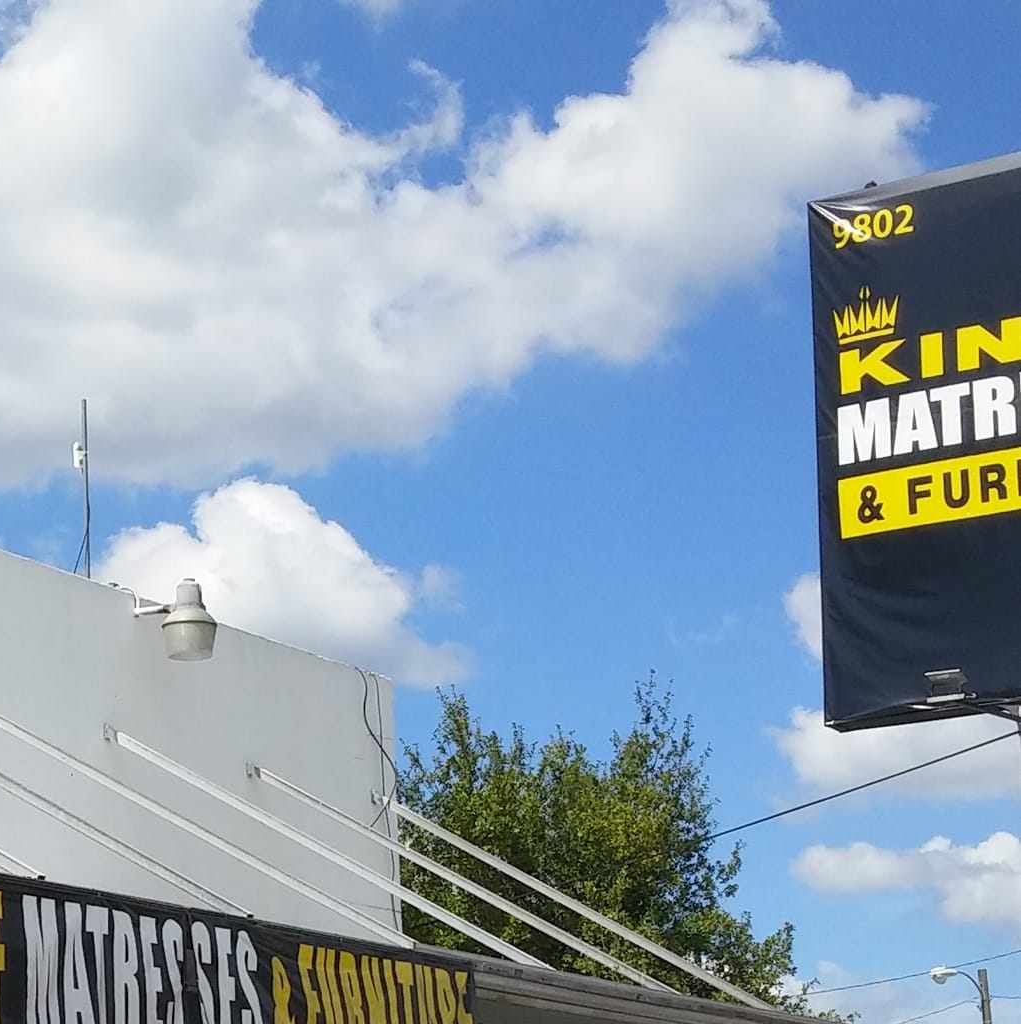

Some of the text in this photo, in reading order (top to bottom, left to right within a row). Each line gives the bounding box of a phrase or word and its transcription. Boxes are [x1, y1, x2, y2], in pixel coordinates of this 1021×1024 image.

[833, 204, 914, 249] 9802
[839, 316, 1021, 395] KIN
[837, 371, 1021, 466] MATR
[857, 459, 1021, 524] & FUR
